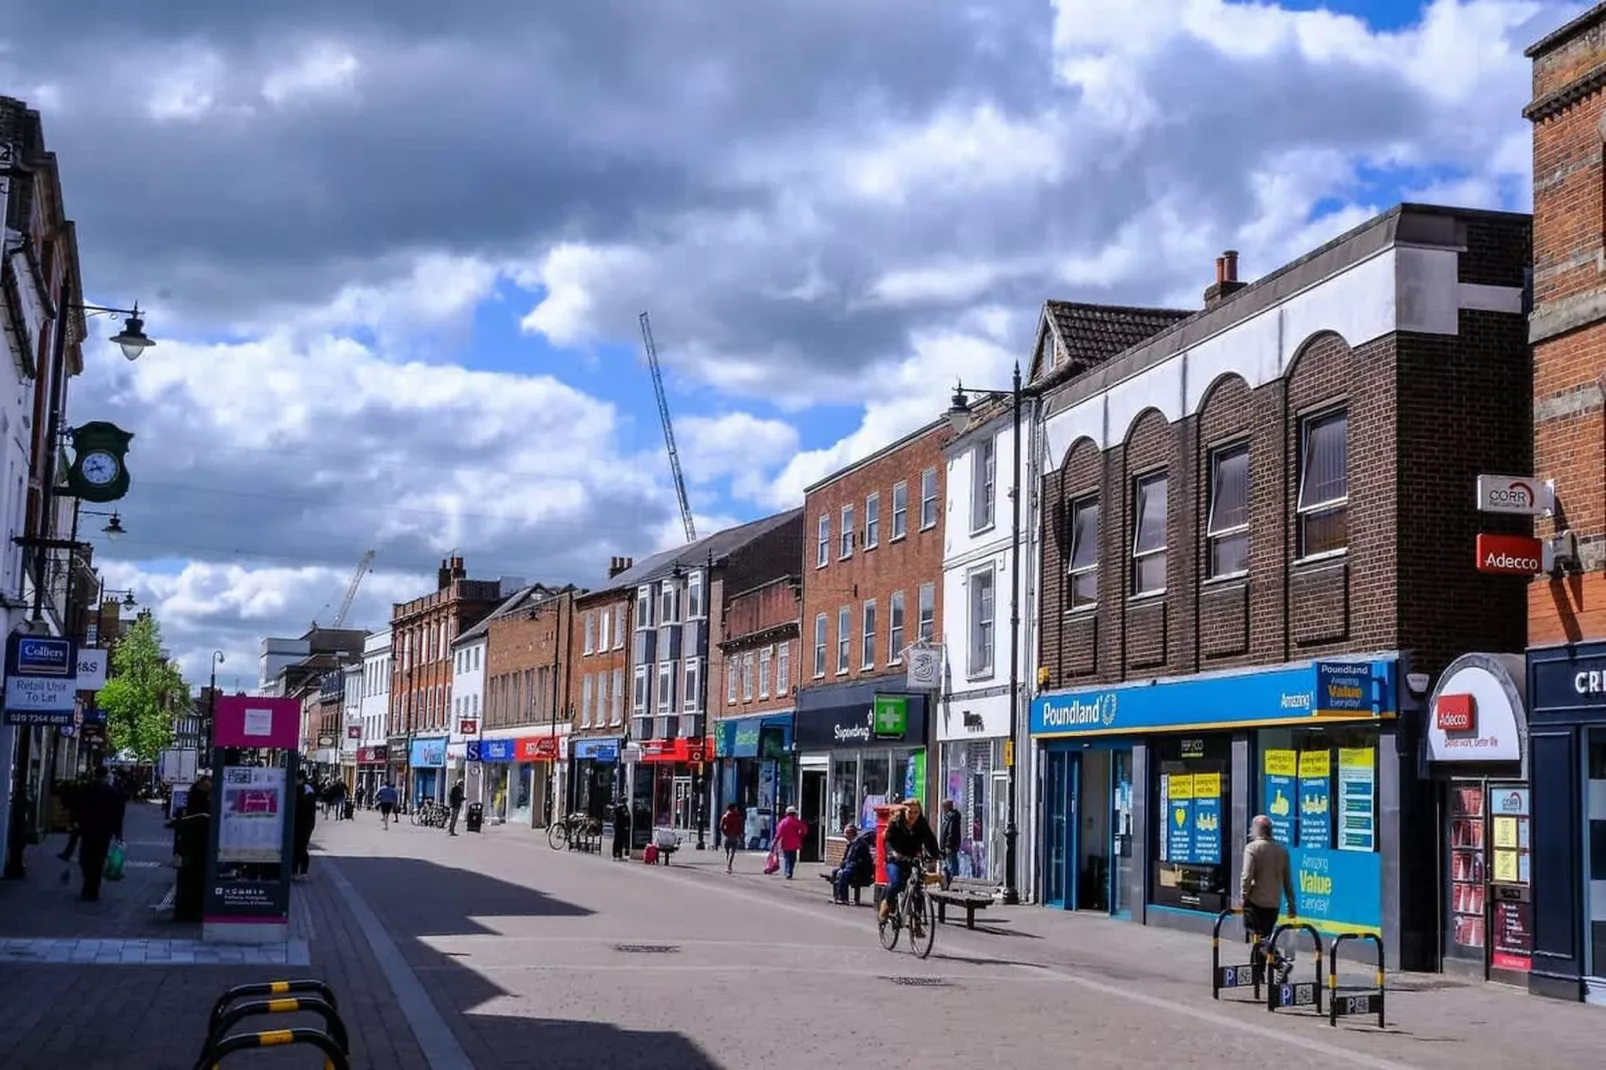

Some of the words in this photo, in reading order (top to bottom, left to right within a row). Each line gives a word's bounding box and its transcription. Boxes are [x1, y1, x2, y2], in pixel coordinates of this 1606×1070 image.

[1489, 490, 1526, 502] CORR
[1485, 552, 1538, 570] Adecco
[24, 643, 64, 657] Colliers
[1321, 664, 1368, 674] Poundland
[16, 680, 45, 691] Retail
[47, 681, 67, 691] Unit
[1328, 684, 1363, 698] Value
[25, 692, 39, 702] To
[42, 692, 57, 703] Let
[1281, 692, 1310, 710] Amazing
[1043, 697, 1100, 727] Poundland
[1439, 711, 1468, 726] Adecco
[834, 723, 870, 742] Superdrug
[1299, 869, 1332, 896] Value
